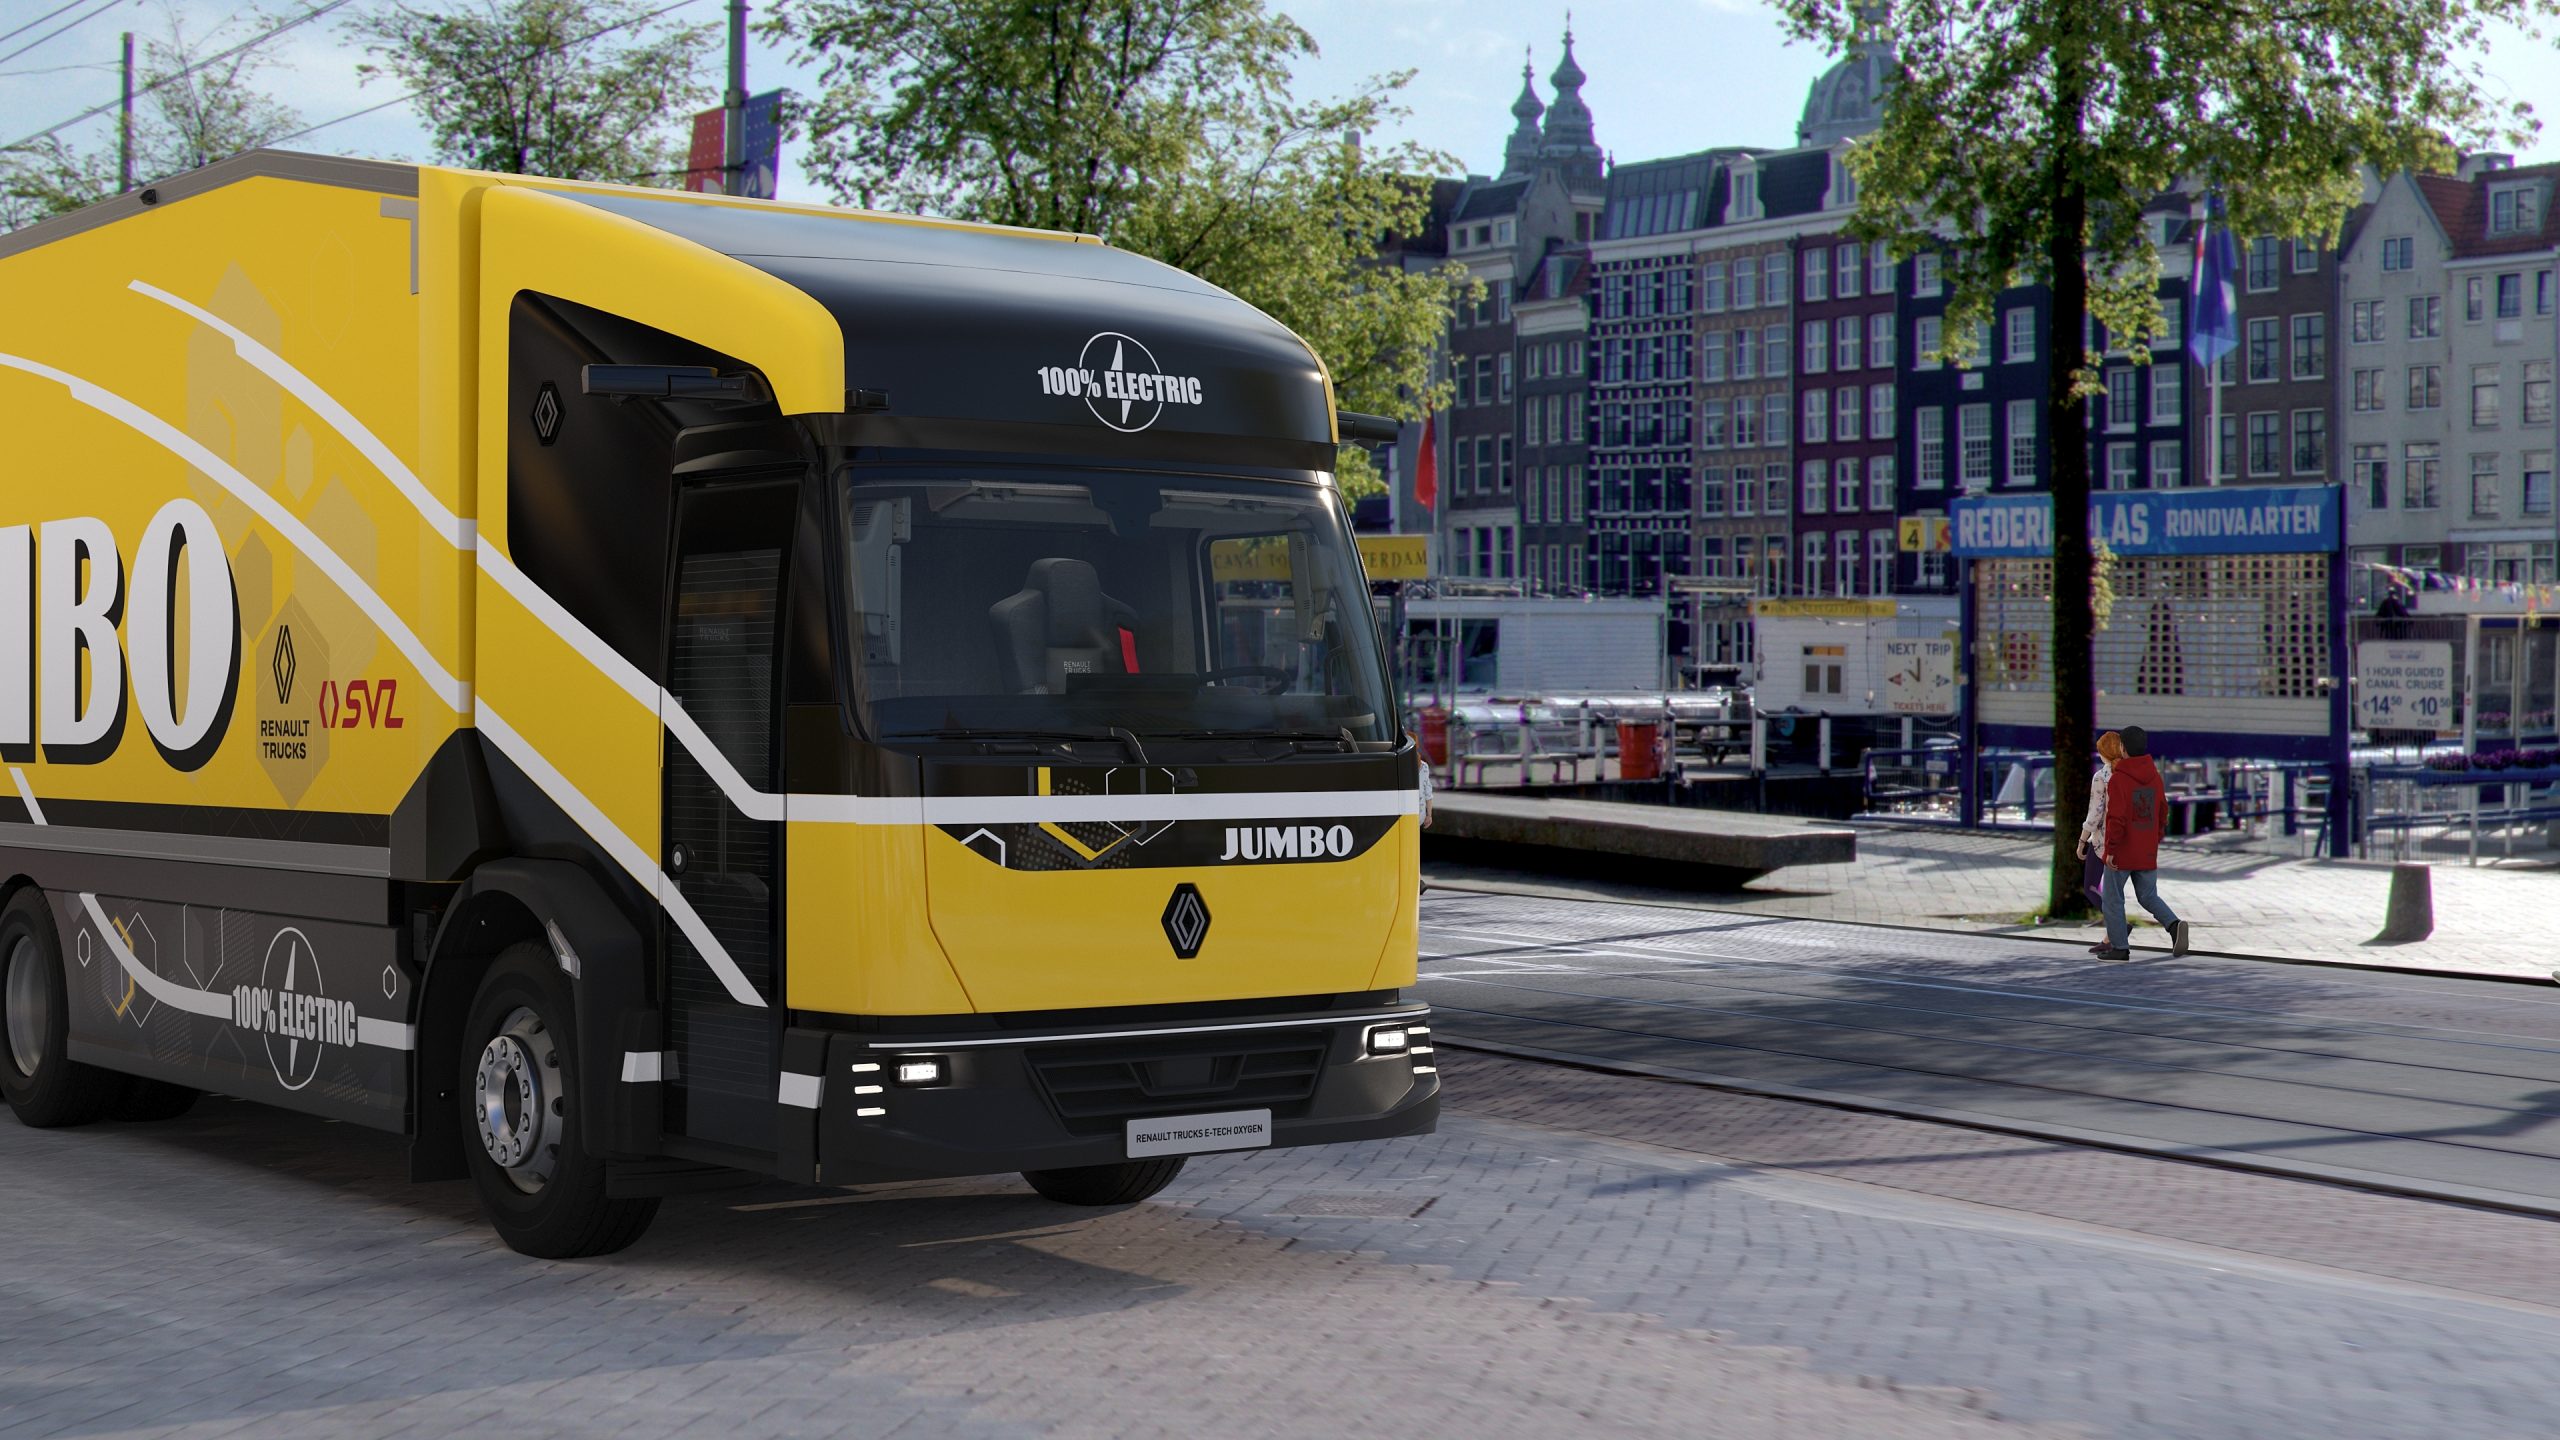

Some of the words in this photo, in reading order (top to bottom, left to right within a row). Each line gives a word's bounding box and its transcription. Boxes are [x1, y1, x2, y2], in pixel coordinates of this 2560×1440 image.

[1037, 366, 1102, 398] 100%
[1103, 370, 1203, 405] ELECTRIC
[1959, 506, 2054, 548] REDERI
[2089, 502, 2149, 546] LAS
[2165, 505, 2321, 537] RONDVAARTEN
[1906, 528, 1920, 549] 4
[1887, 642, 1917, 656] NEXT
[1925, 642, 1951, 656] TRIP
[1063, 660, 1091, 668] RENAULT
[2373, 667, 2402, 676] HOUR
[2404, 667, 2445, 677] GUIDED
[2366, 679, 2402, 689] CANAL
[2406, 680, 2445, 690] CRUISE
[341, 678, 404, 729] SVZ
[1893, 702, 1924, 712] TICKETS
[1926, 703, 1947, 712] HERE
[260, 720, 310, 737] RENAULT
[262, 742, 307, 760] TRUCKS
[1220, 824, 1354, 861] JUMBO
[232, 984, 276, 1034] 100%
[279, 991, 356, 1048] ELECTRIC
[1136, 1131, 1171, 1143] RENAULT
[1172, 1128, 1203, 1140] TRUCKS
[1204, 1126, 1232, 1137] E-TECH
[1233, 1124, 1263, 1135] OXYGEN
